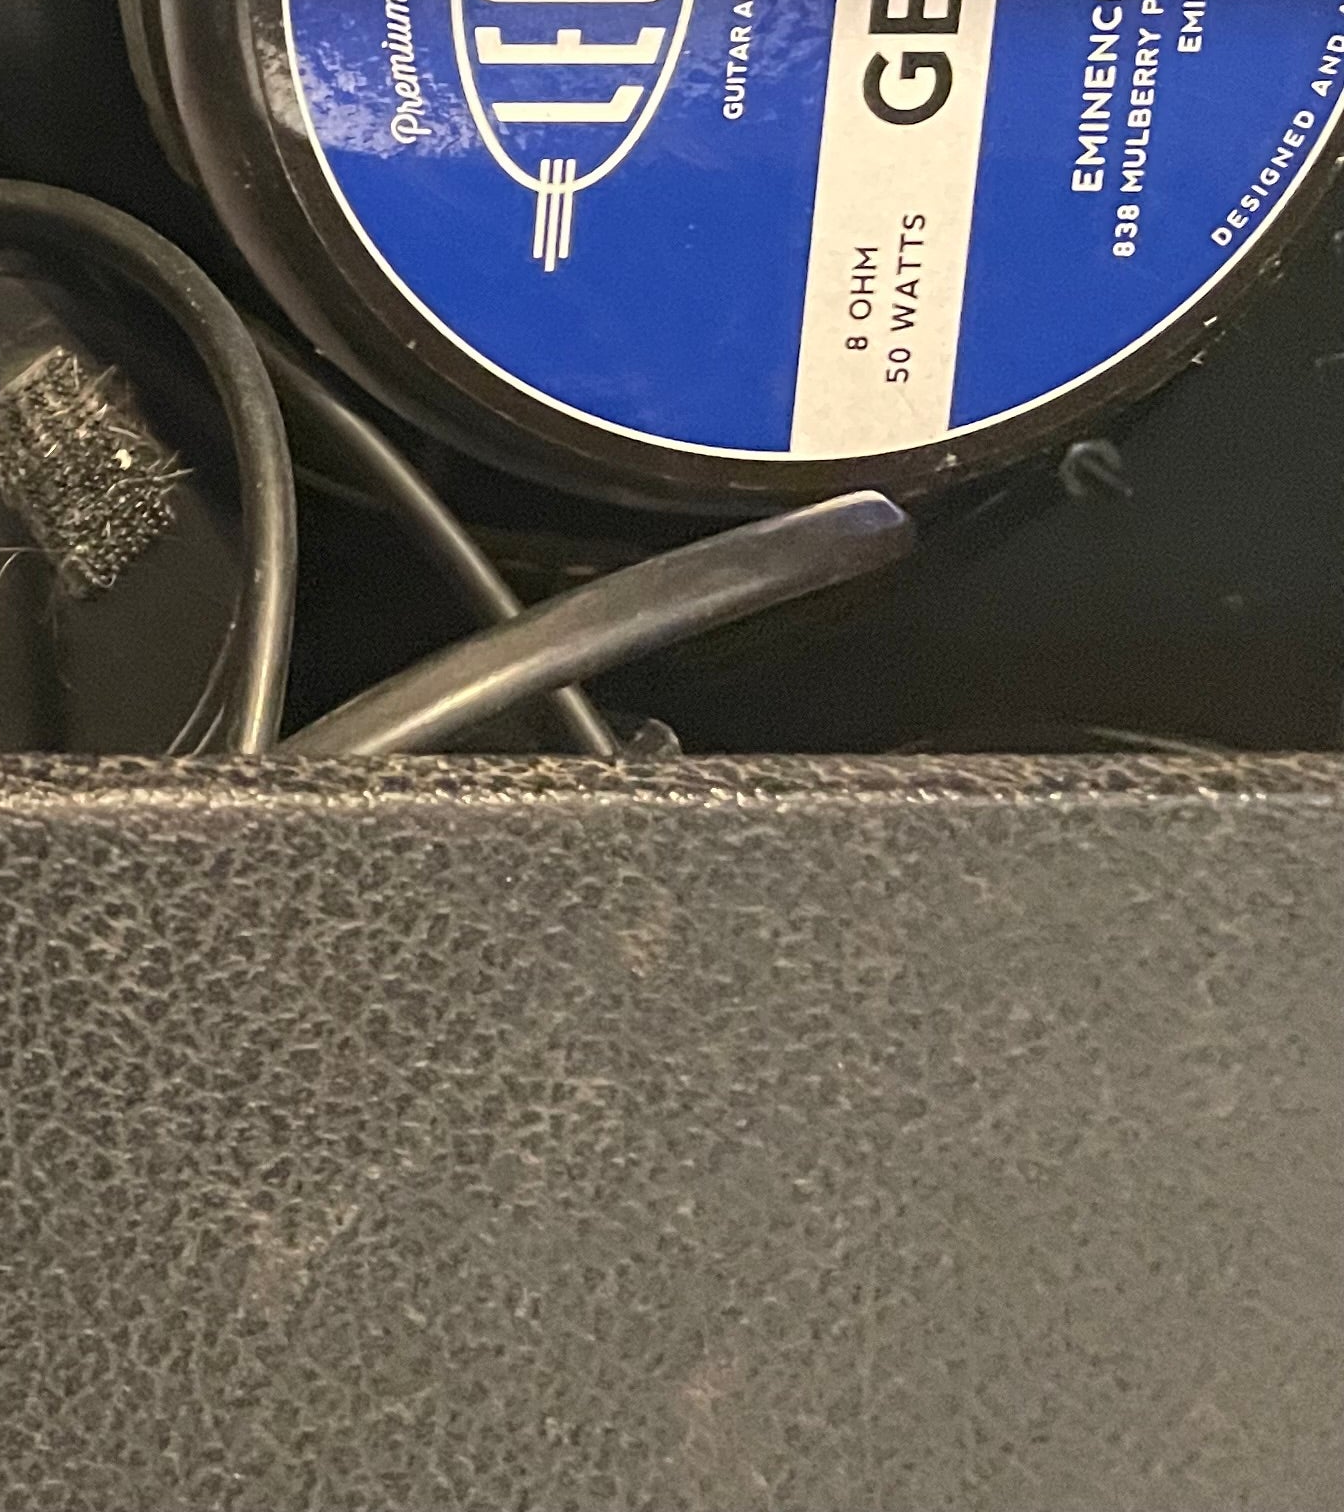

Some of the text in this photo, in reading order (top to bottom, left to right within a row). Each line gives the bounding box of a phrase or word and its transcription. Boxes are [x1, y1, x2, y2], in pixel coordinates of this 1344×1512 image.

[723, 26, 751, 120] GUITAR
[1119, 27, 1162, 193] MULBERRY
[1211, 35, 1344, 246] DESIGNED AND
[885, 214, 926, 383] 50 WATTS
[1112, 204, 1141, 258] 838
[845, 247, 879, 351] 8 OHM
